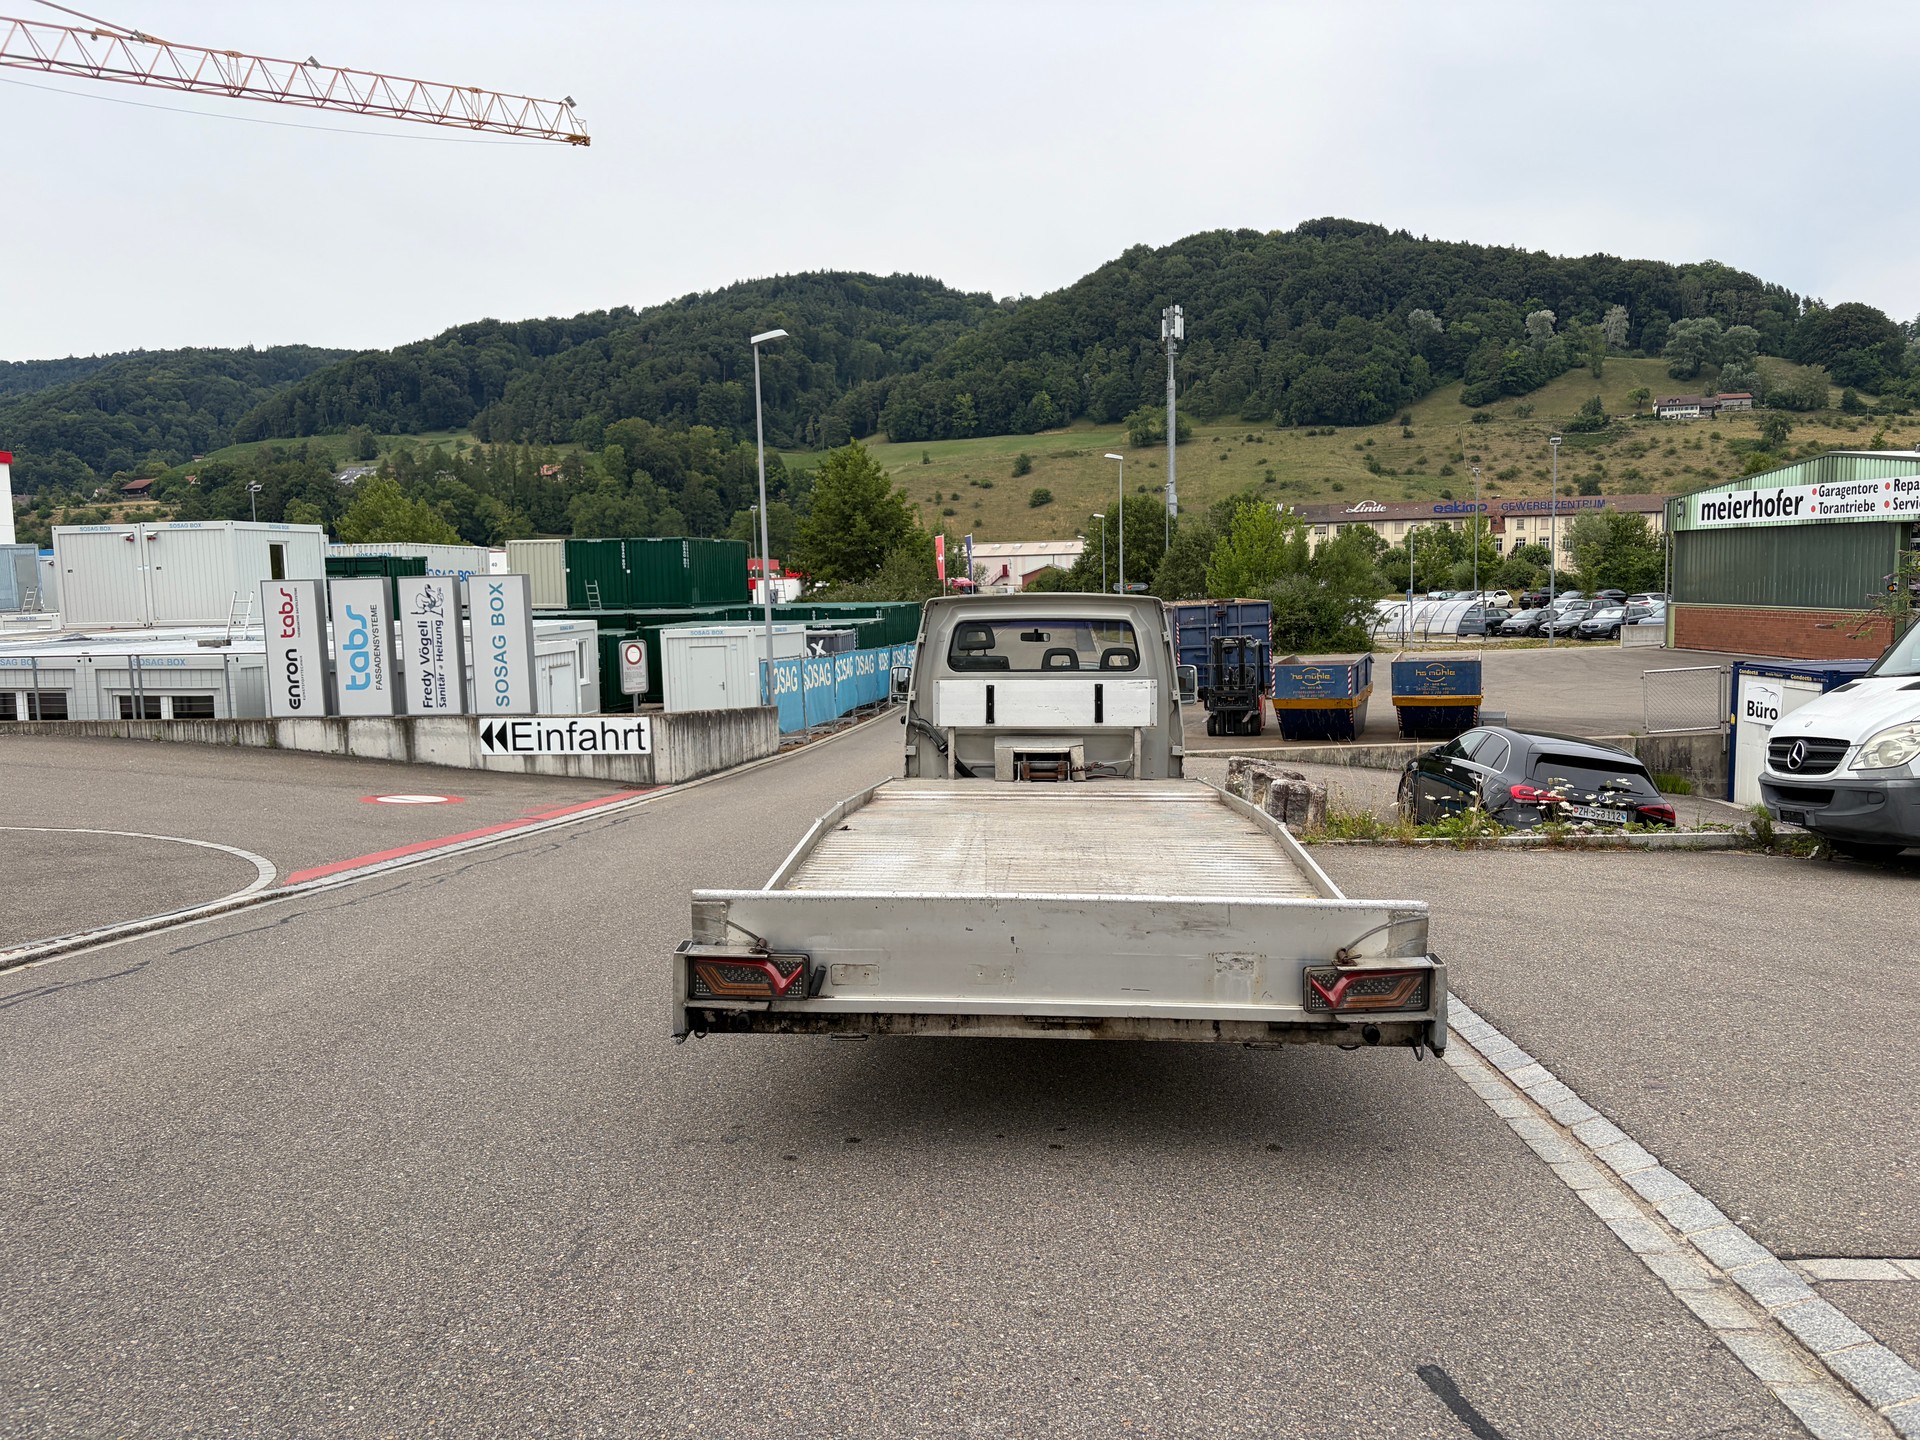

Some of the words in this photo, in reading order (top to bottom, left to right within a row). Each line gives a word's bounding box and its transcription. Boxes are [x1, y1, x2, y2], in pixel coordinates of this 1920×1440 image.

[1345, 500, 1387, 513] Linde
[1433, 501, 1488, 513] eskimo
[1501, 499, 1606, 511] GEWERBEZENTRUM
[1701, 488, 1804, 521] meierhofer
[1818, 483, 1879, 499] Garagentore
[1818, 500, 1876, 514] Torantriebe
[279, 587, 296, 638] tabs
[488, 582, 505, 626] BOX
[342, 604, 371, 691] tabs
[370, 604, 382, 690] FASSADENSYSTEME
[417, 620, 432, 665] Vögeli
[435, 620, 444, 662] Heizung
[166, 658, 186, 666] BOX
[285, 648, 301, 709] enron
[492, 635, 510, 707] SOSAG
[421, 670, 434, 708] Fredy
[437, 673, 447, 708] Sanitär
[1747, 700, 1778, 720] Büro
[511, 721, 646, 751] Einfahrt
